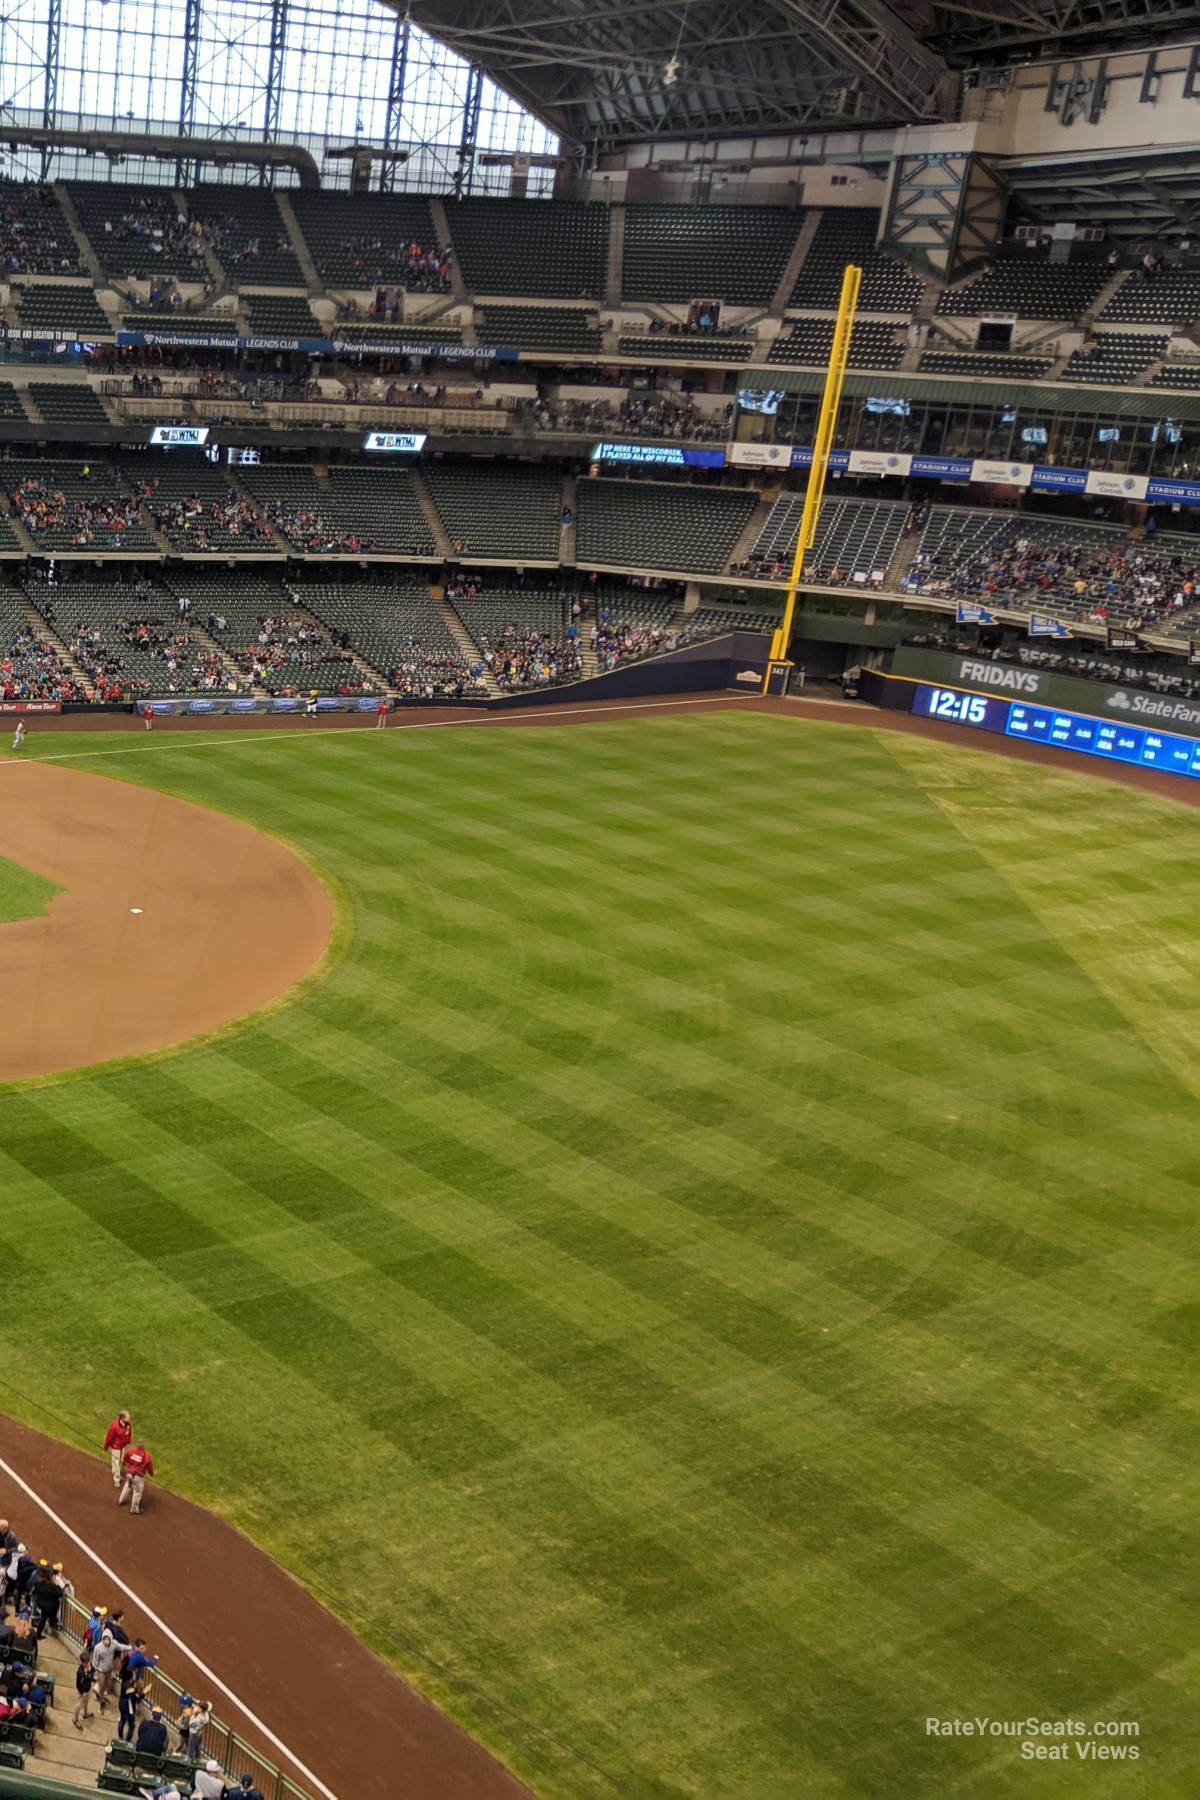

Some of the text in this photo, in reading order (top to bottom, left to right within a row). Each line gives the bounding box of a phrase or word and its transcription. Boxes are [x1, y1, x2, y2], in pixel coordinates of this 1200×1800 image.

[154, 336, 299, 350] Northwestern Mutual LEGENDS CLUB
[343, 342, 497, 358] Northwestern Mutual LEGENDS CLUB
[613, 445, 631, 453] HERE
[606, 451, 632, 460] PLAYED
[912, 463, 948, 471] STADIUM
[1033, 474, 1086, 484] STADIUM CLUB
[1149, 486, 1200, 497] STADIUM CLU
[959, 661, 1042, 693] FRIDAYS
[928, 690, 988, 723] 12:15
